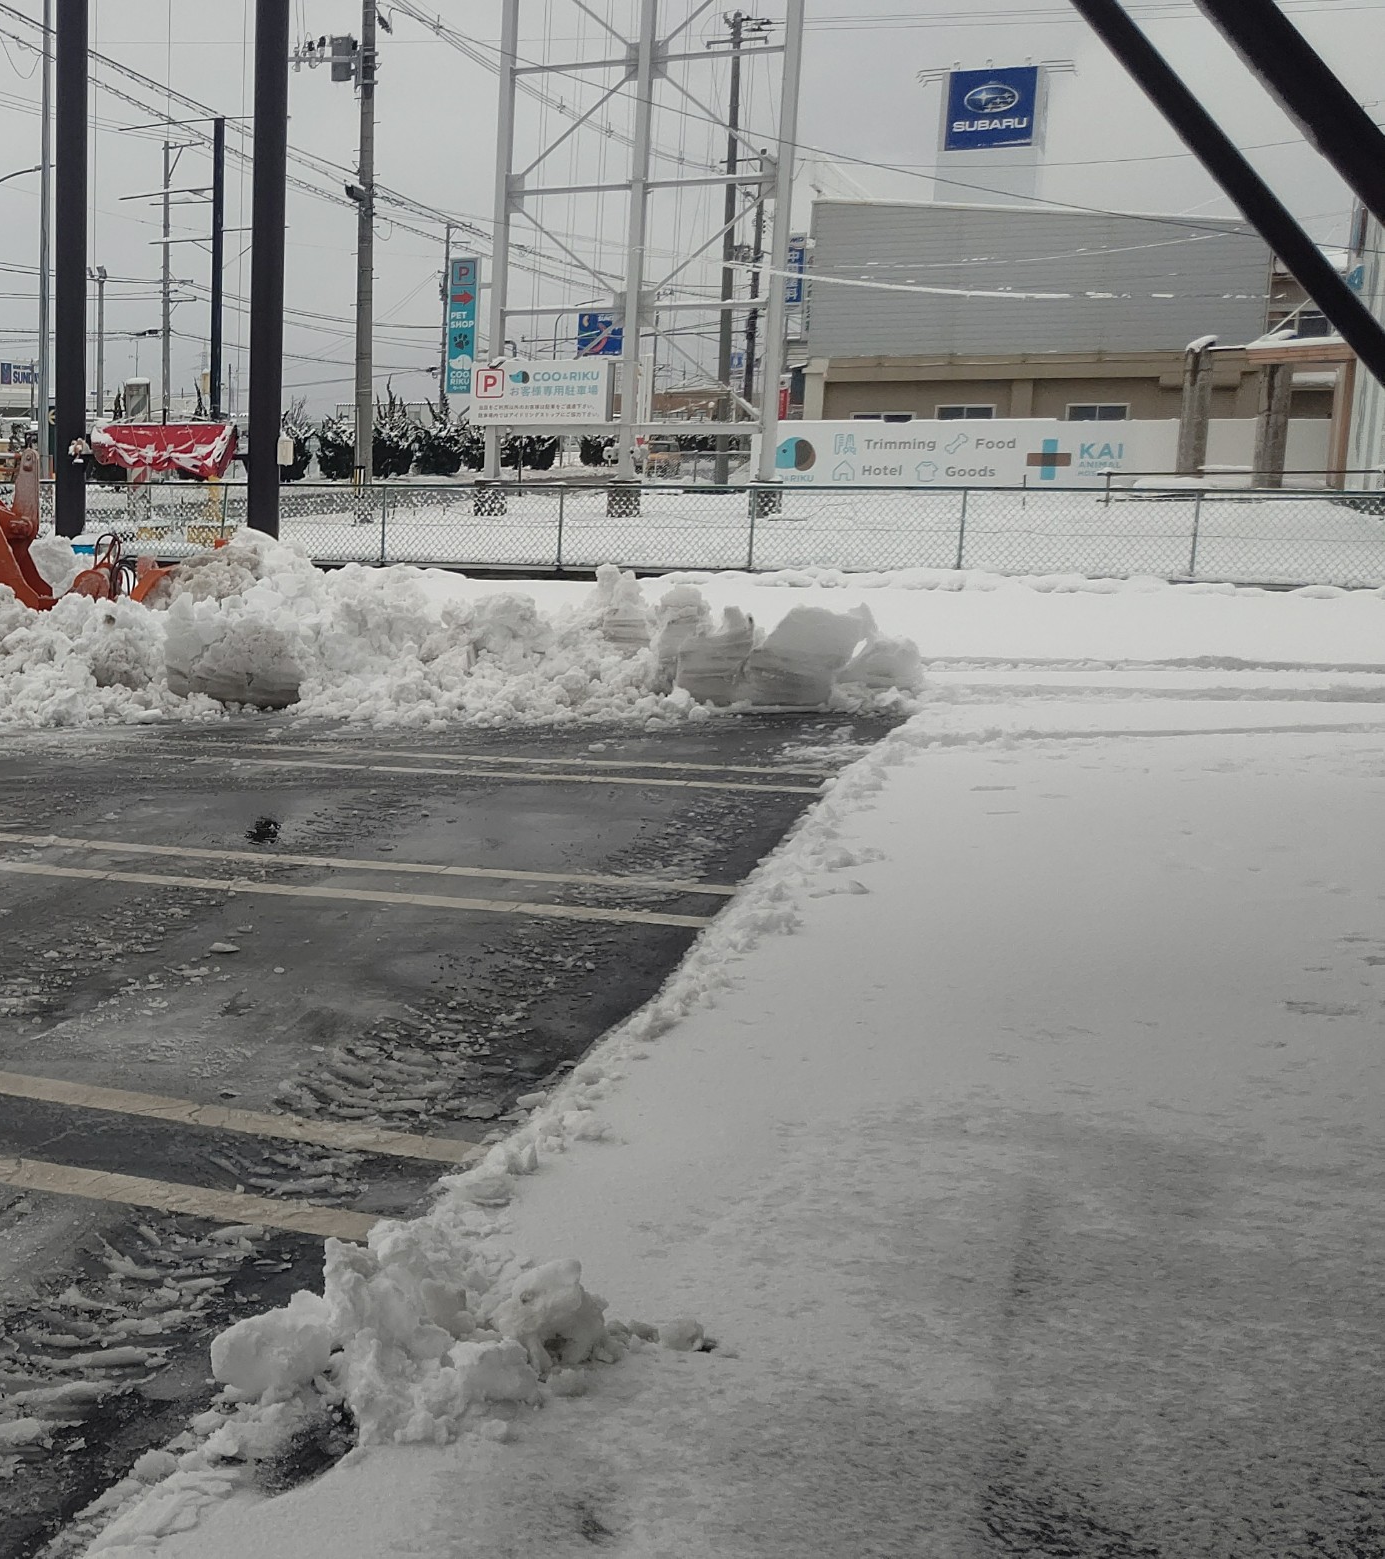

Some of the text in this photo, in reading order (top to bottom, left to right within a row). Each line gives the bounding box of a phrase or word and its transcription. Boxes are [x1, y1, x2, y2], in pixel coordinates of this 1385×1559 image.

[952, 117, 1028, 132] SUBARU
[458, 266, 470, 280] P
[450, 311, 468, 319] PET
[450, 320, 475, 329] SHOP
[450, 370, 470, 378] COO
[450, 378, 470, 386] RIKU
[483, 375, 497, 392] P
[509, 385, 599, 397] お客様専用駐車場
[864, 438, 1017, 452] Trimming Food
[1079, 443, 1124, 460] KAI
[861, 464, 996, 477] Hotel Goods
